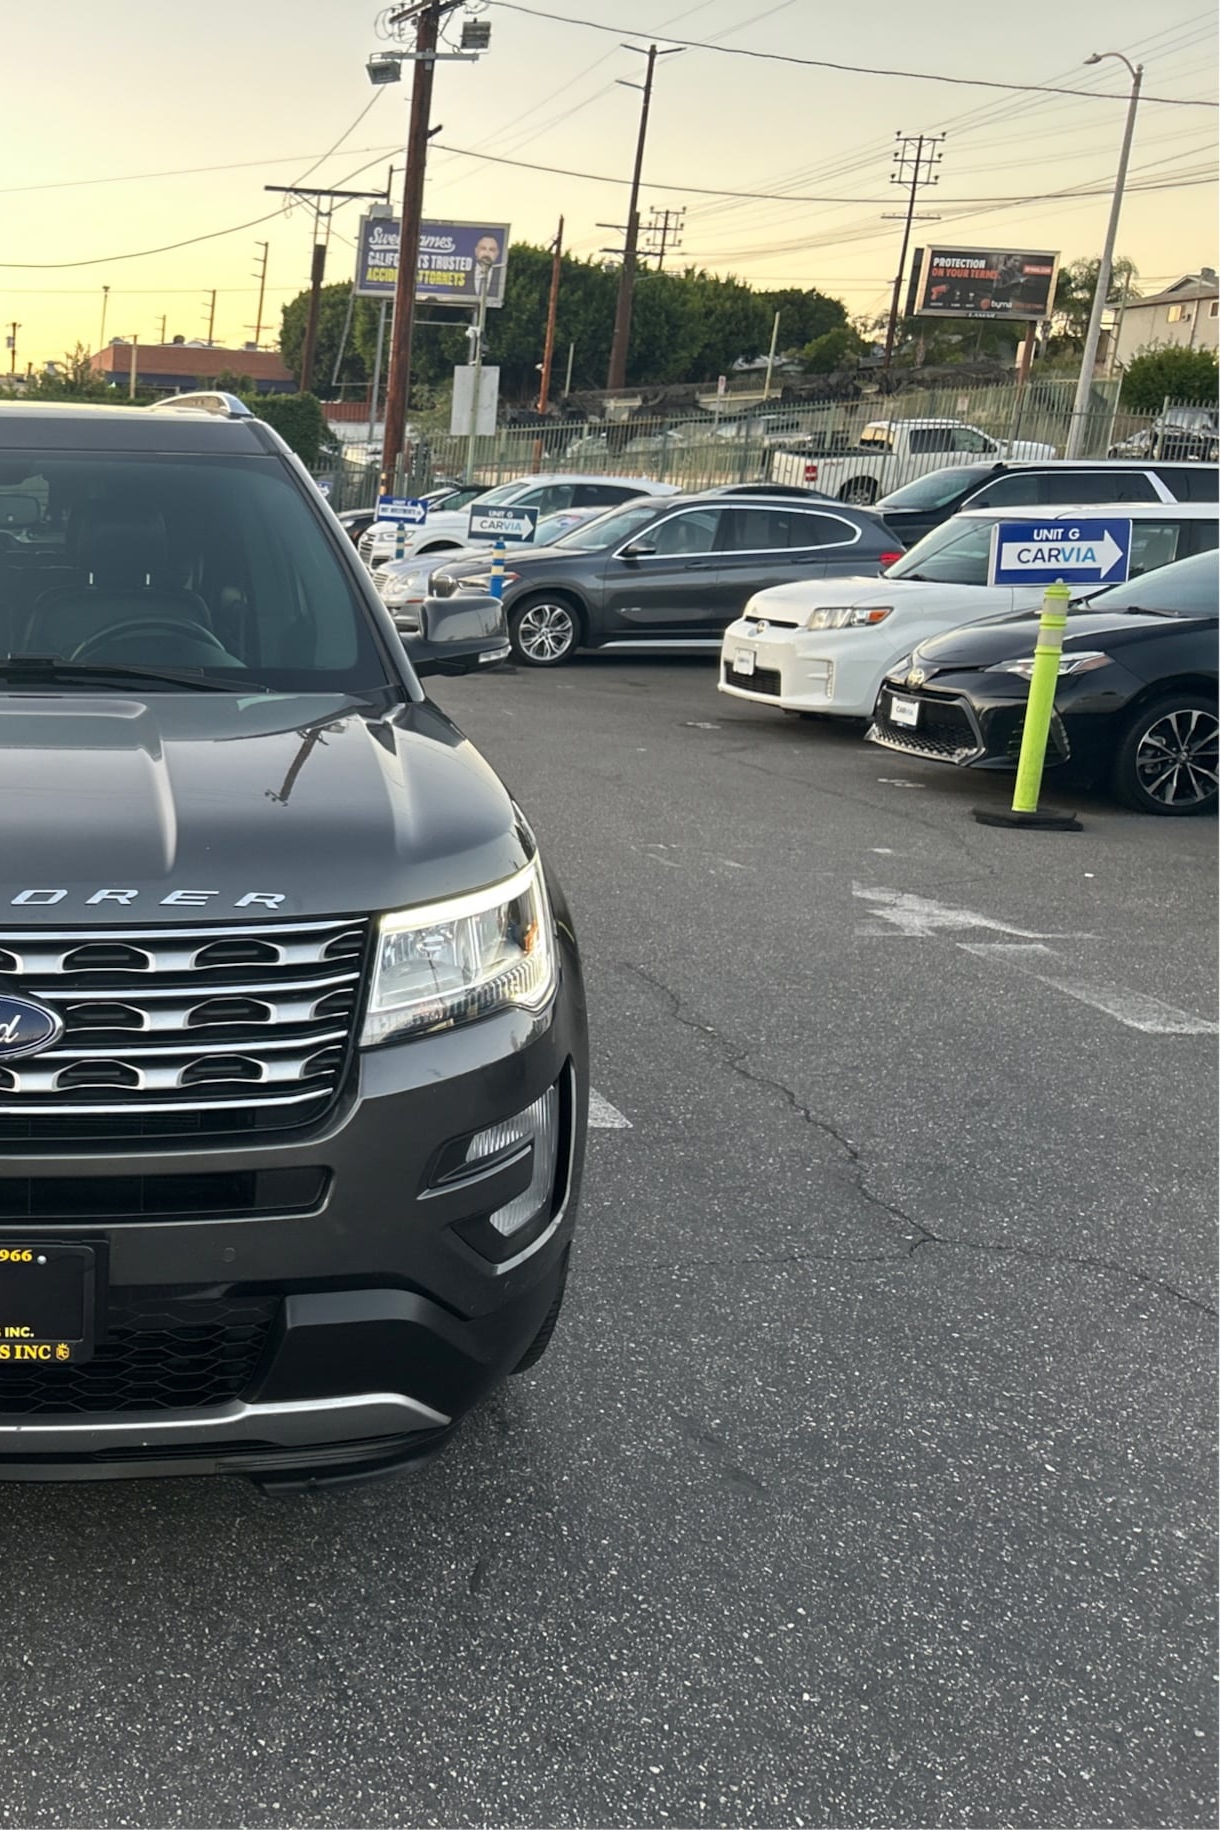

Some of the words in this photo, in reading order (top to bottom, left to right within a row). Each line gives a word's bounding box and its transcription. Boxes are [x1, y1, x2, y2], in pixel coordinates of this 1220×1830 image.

[419, 235, 453, 249] ames
[431, 255, 472, 271] TRUSTED
[933, 257, 986, 269] PROTECTION
[417, 271, 466, 286] TTORNEYS
[932, 268, 944, 277] ON
[946, 269, 968, 278] YOUR
[488, 509, 505, 518] UNIT
[480, 520, 522, 532] CARVIA
[1033, 528, 1064, 541] UNIT
[1068, 528, 1080, 540] G
[1017, 547, 1096, 564] CARVIA
[5, 1327, 35, 1338] INC.
[14, 1344, 52, 1360] INC
